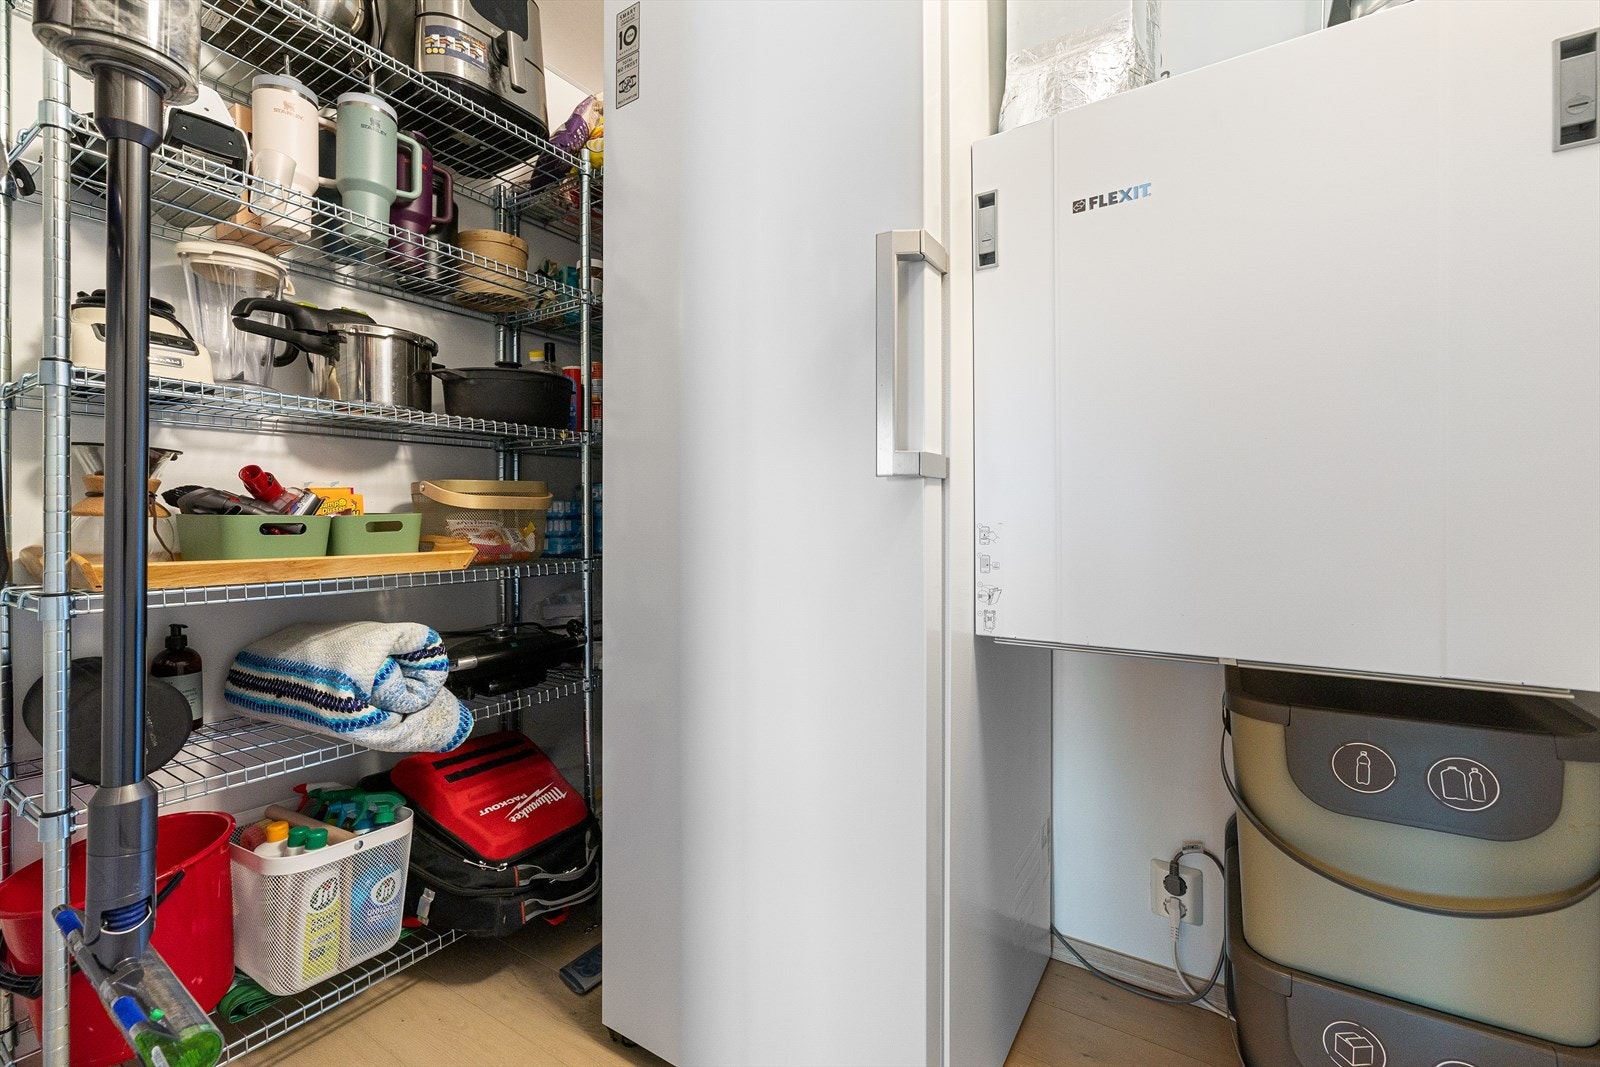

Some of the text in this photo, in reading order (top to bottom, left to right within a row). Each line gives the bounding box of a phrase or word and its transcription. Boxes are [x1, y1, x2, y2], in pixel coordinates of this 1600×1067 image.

[619, 7, 636, 20] SMART
[618, 25, 638, 50] 10
[360, 123, 388, 137] STANLEY
[1088, 182, 1151, 211] FLEXIT
[479, 793, 528, 817] PACKOUT
[508, 786, 568, 823] Milwaukee
